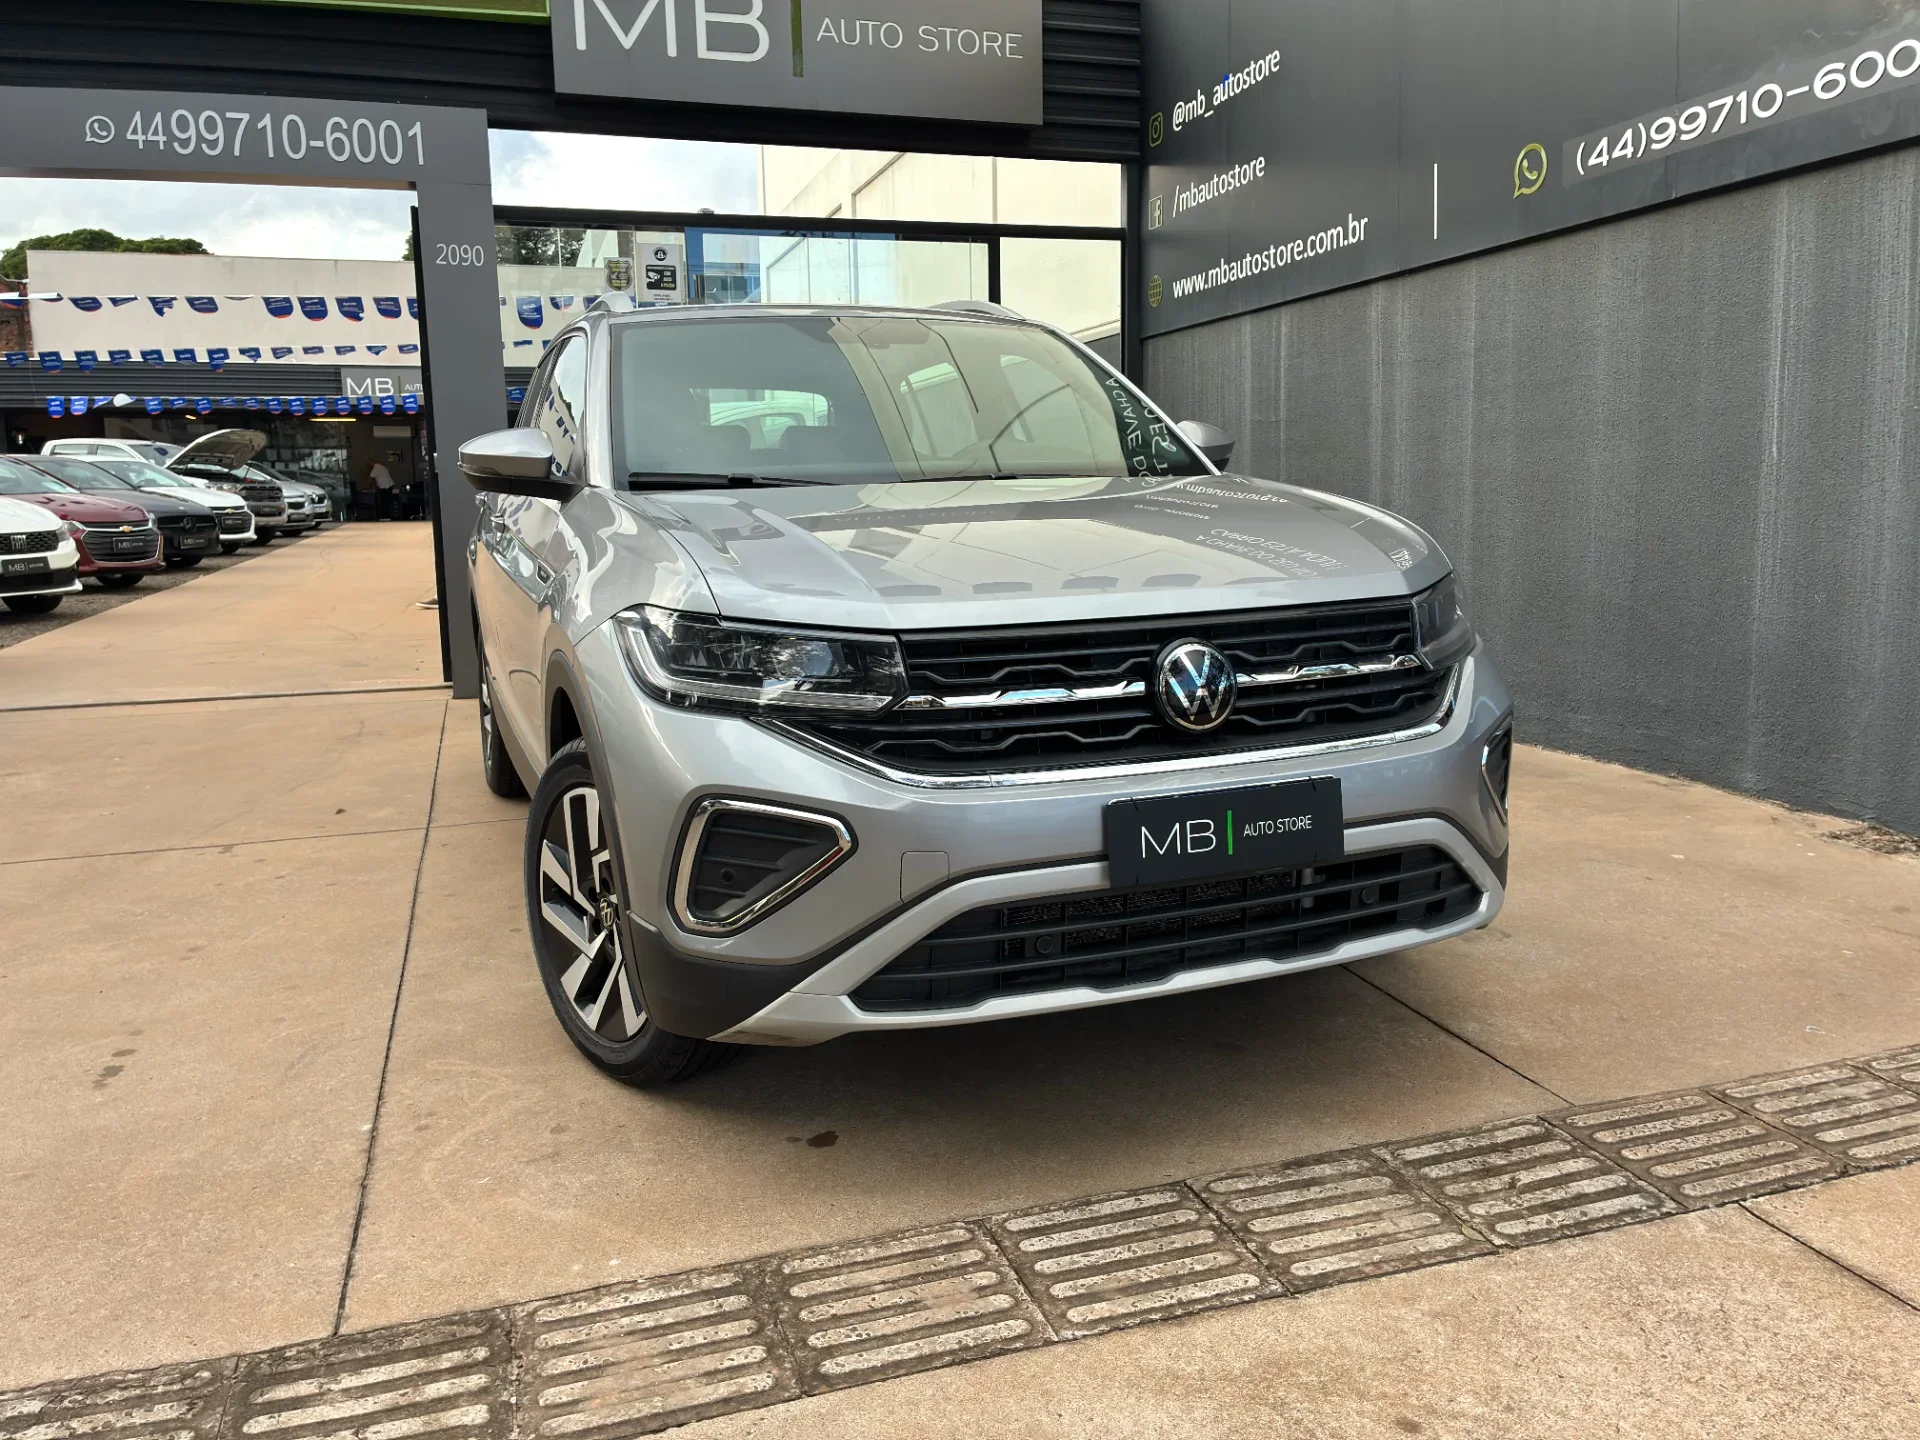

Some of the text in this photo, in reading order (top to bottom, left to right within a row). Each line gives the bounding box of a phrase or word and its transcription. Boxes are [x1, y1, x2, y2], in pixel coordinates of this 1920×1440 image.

[573, 0, 1024, 62] MB AUTO STORE
[1172, 49, 1281, 132] @mb_autostore
[1575, 38, 1920, 175] (44)99710-600
[126, 109, 426, 166] 4499710-6001
[1172, 156, 1266, 218] /mbautostore
[435, 244, 484, 267] 2090
[1172, 213, 1368, 299] www.mbautostore.com.br
[346, 377, 394, 396] MB
[8, 563, 25, 572] MB
[1141, 815, 1312, 858] MB AUTO STORE
